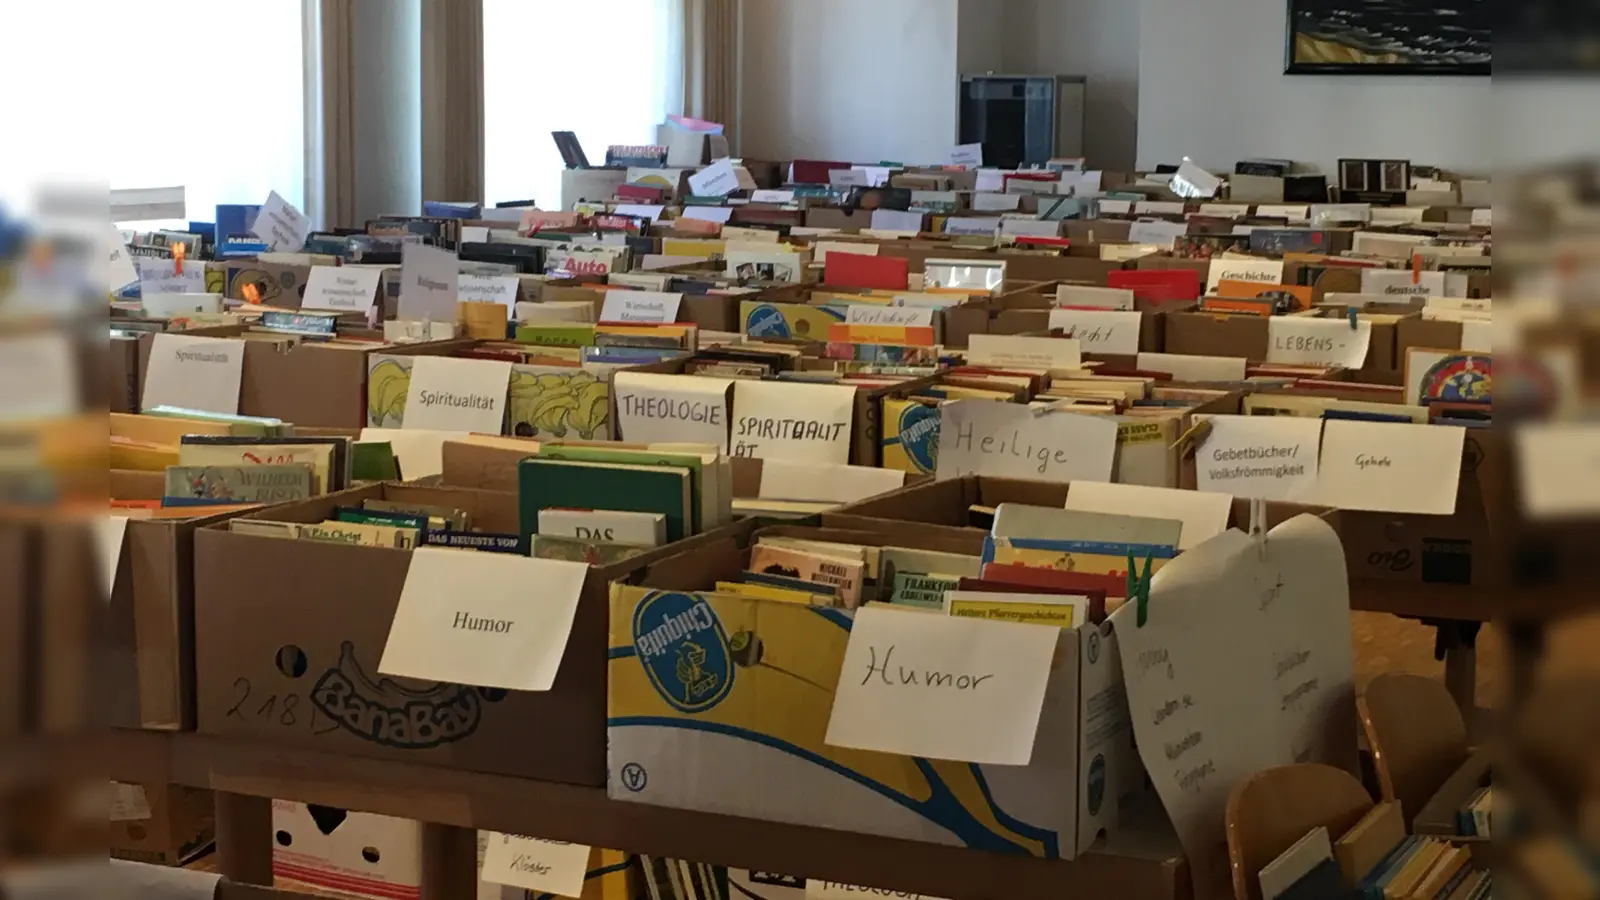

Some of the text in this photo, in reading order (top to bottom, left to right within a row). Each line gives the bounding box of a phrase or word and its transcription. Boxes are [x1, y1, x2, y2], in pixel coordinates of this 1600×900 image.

[564, 257, 608, 275] Auto
[1220, 269, 1278, 283] Geschichte
[1384, 284, 1431, 296] deutsche
[419, 389, 495, 411] Spiritualität
[622, 394, 722, 426] THEOLOGIE
[956, 420, 1069, 474] Heilige
[1212, 443, 1300, 463] Gebetbücher/
[1208, 462, 1305, 481] Volksfrömmigkeit
[574, 526, 615, 541] DAS
[452, 610, 515, 634] Humor
[637, 601, 714, 663] Chiquita
[861, 644, 995, 691] Humor
